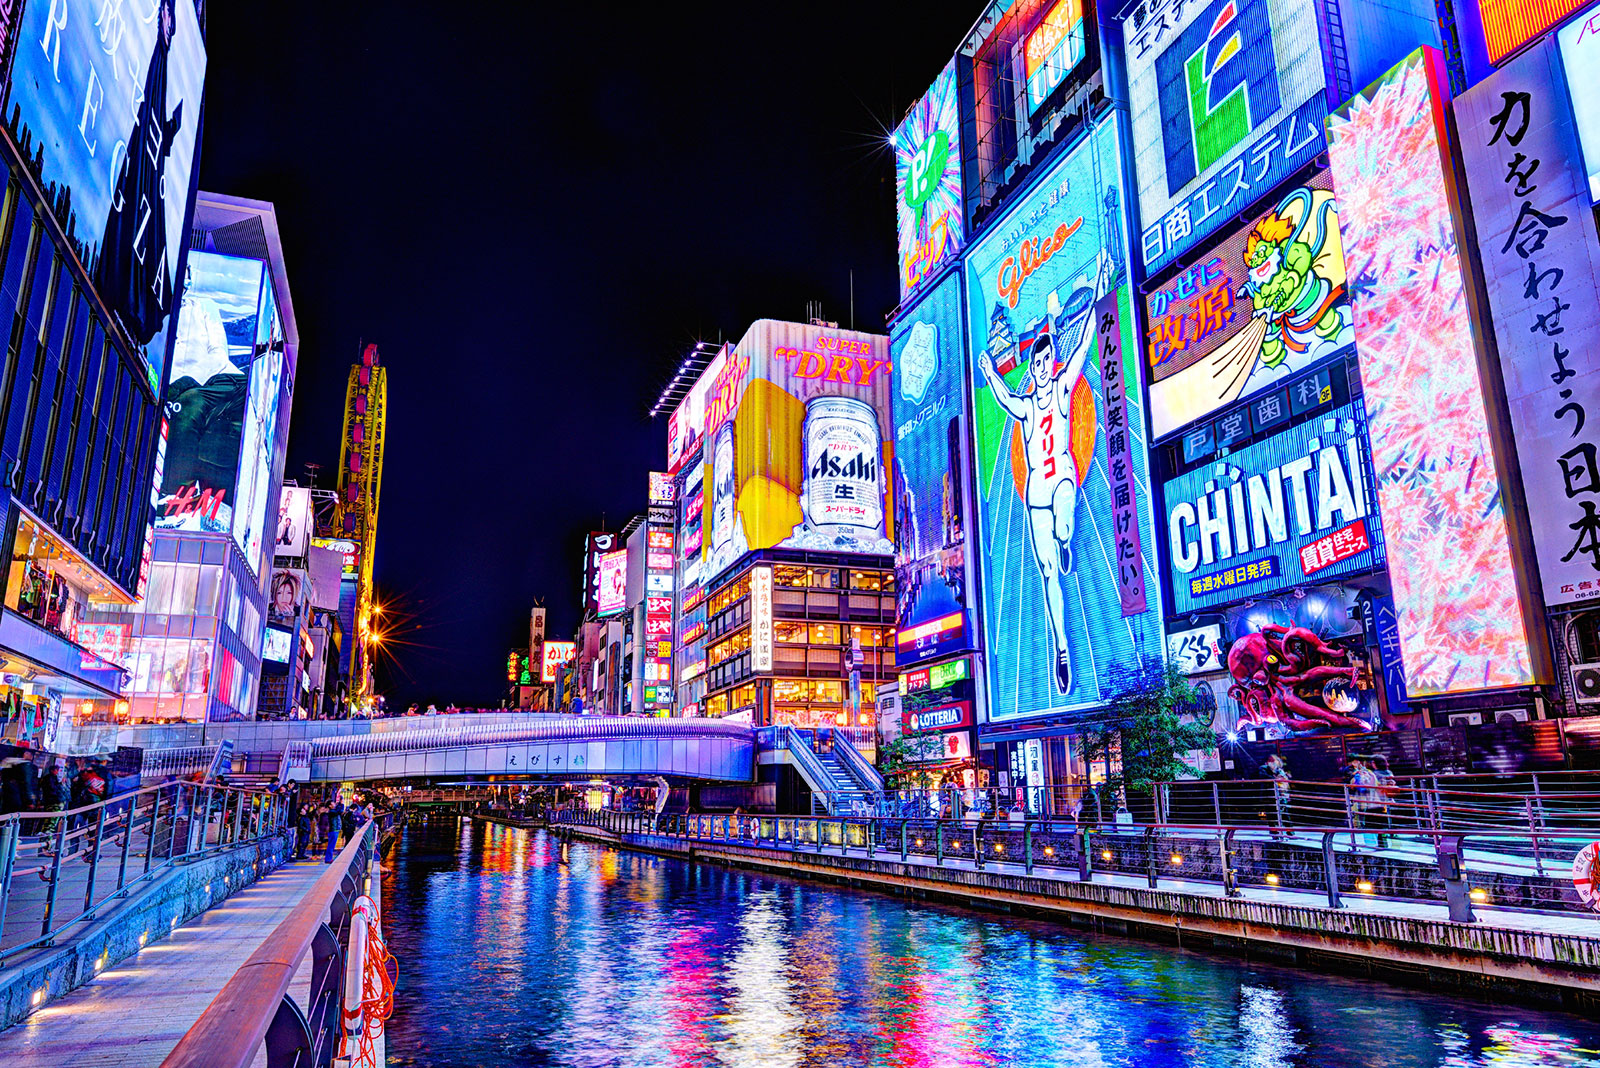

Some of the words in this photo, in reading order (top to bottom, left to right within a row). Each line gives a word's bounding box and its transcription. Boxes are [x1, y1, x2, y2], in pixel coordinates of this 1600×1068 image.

[1136, 0, 1198, 59] エステ
[1141, 116, 1319, 266] 日商エステム
[904, 208, 950, 289] ピップ
[997, 217, 1083, 309] Glico
[1151, 257, 1225, 318] かぜに
[1147, 277, 1236, 367] 改源
[1487, 91, 1600, 571] 力を合わせよう日本
[815, 336, 871, 355] SUPER
[1321, 389, 1331, 402] 3F
[898, 394, 946, 440] 雪印メグミルク
[1039, 409, 1057, 480] グリコ
[1101, 312, 1140, 596] みんなに笑顔を届けたい。
[811, 448, 876, 483] Asahi
[164, 485, 227, 521] H&M
[834, 483, 855, 500] 生
[825, 505, 866, 516] スーパードライ
[1333, 527, 1354, 545] 住宅
[1336, 535, 1368, 558] ニュース
[1301, 542, 1336, 573] 賃貸
[1191, 560, 1272, 595] 毎週水曜日発売
[1560, 579, 1600, 593] 広告
[1363, 600, 1373, 632] 2F
[919, 708, 958, 727] LOTTERIA
